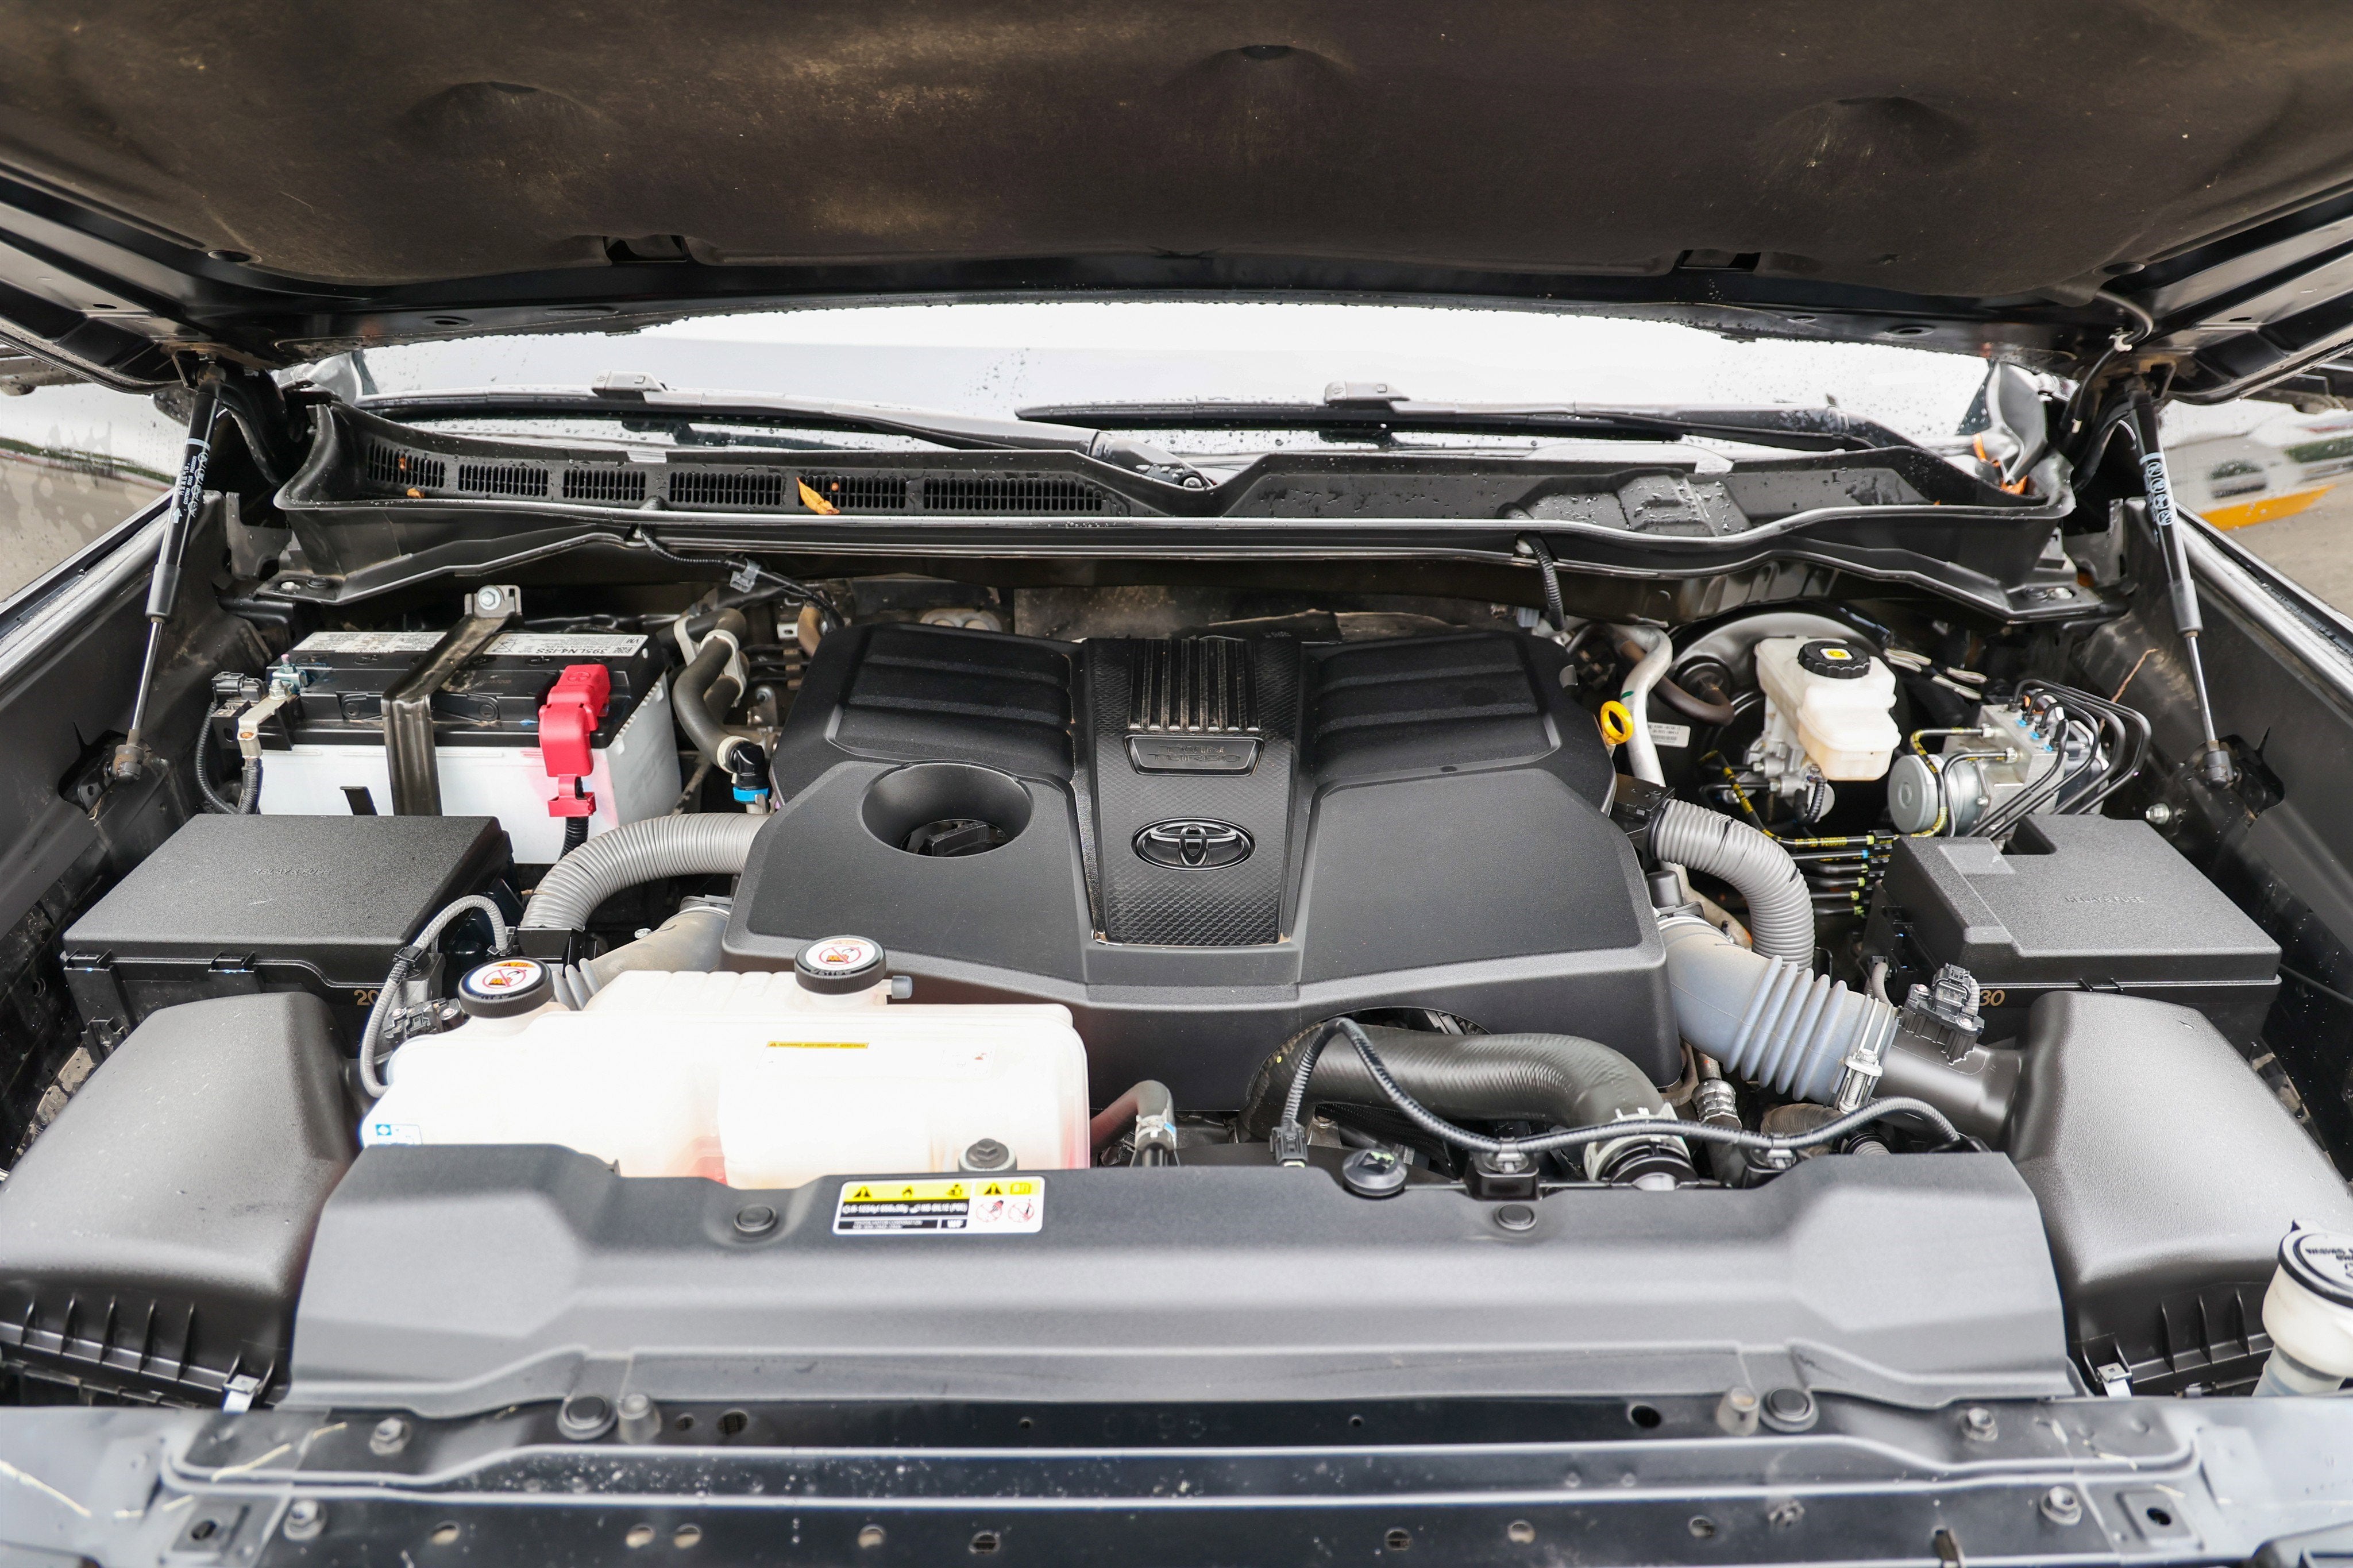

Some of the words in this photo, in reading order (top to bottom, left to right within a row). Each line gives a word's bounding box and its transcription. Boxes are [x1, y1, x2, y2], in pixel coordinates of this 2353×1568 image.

[1159, 745, 1224, 754] TWIN
[1148, 753, 1241, 762] TURBO
[1979, 990, 2005, 1006] 30
